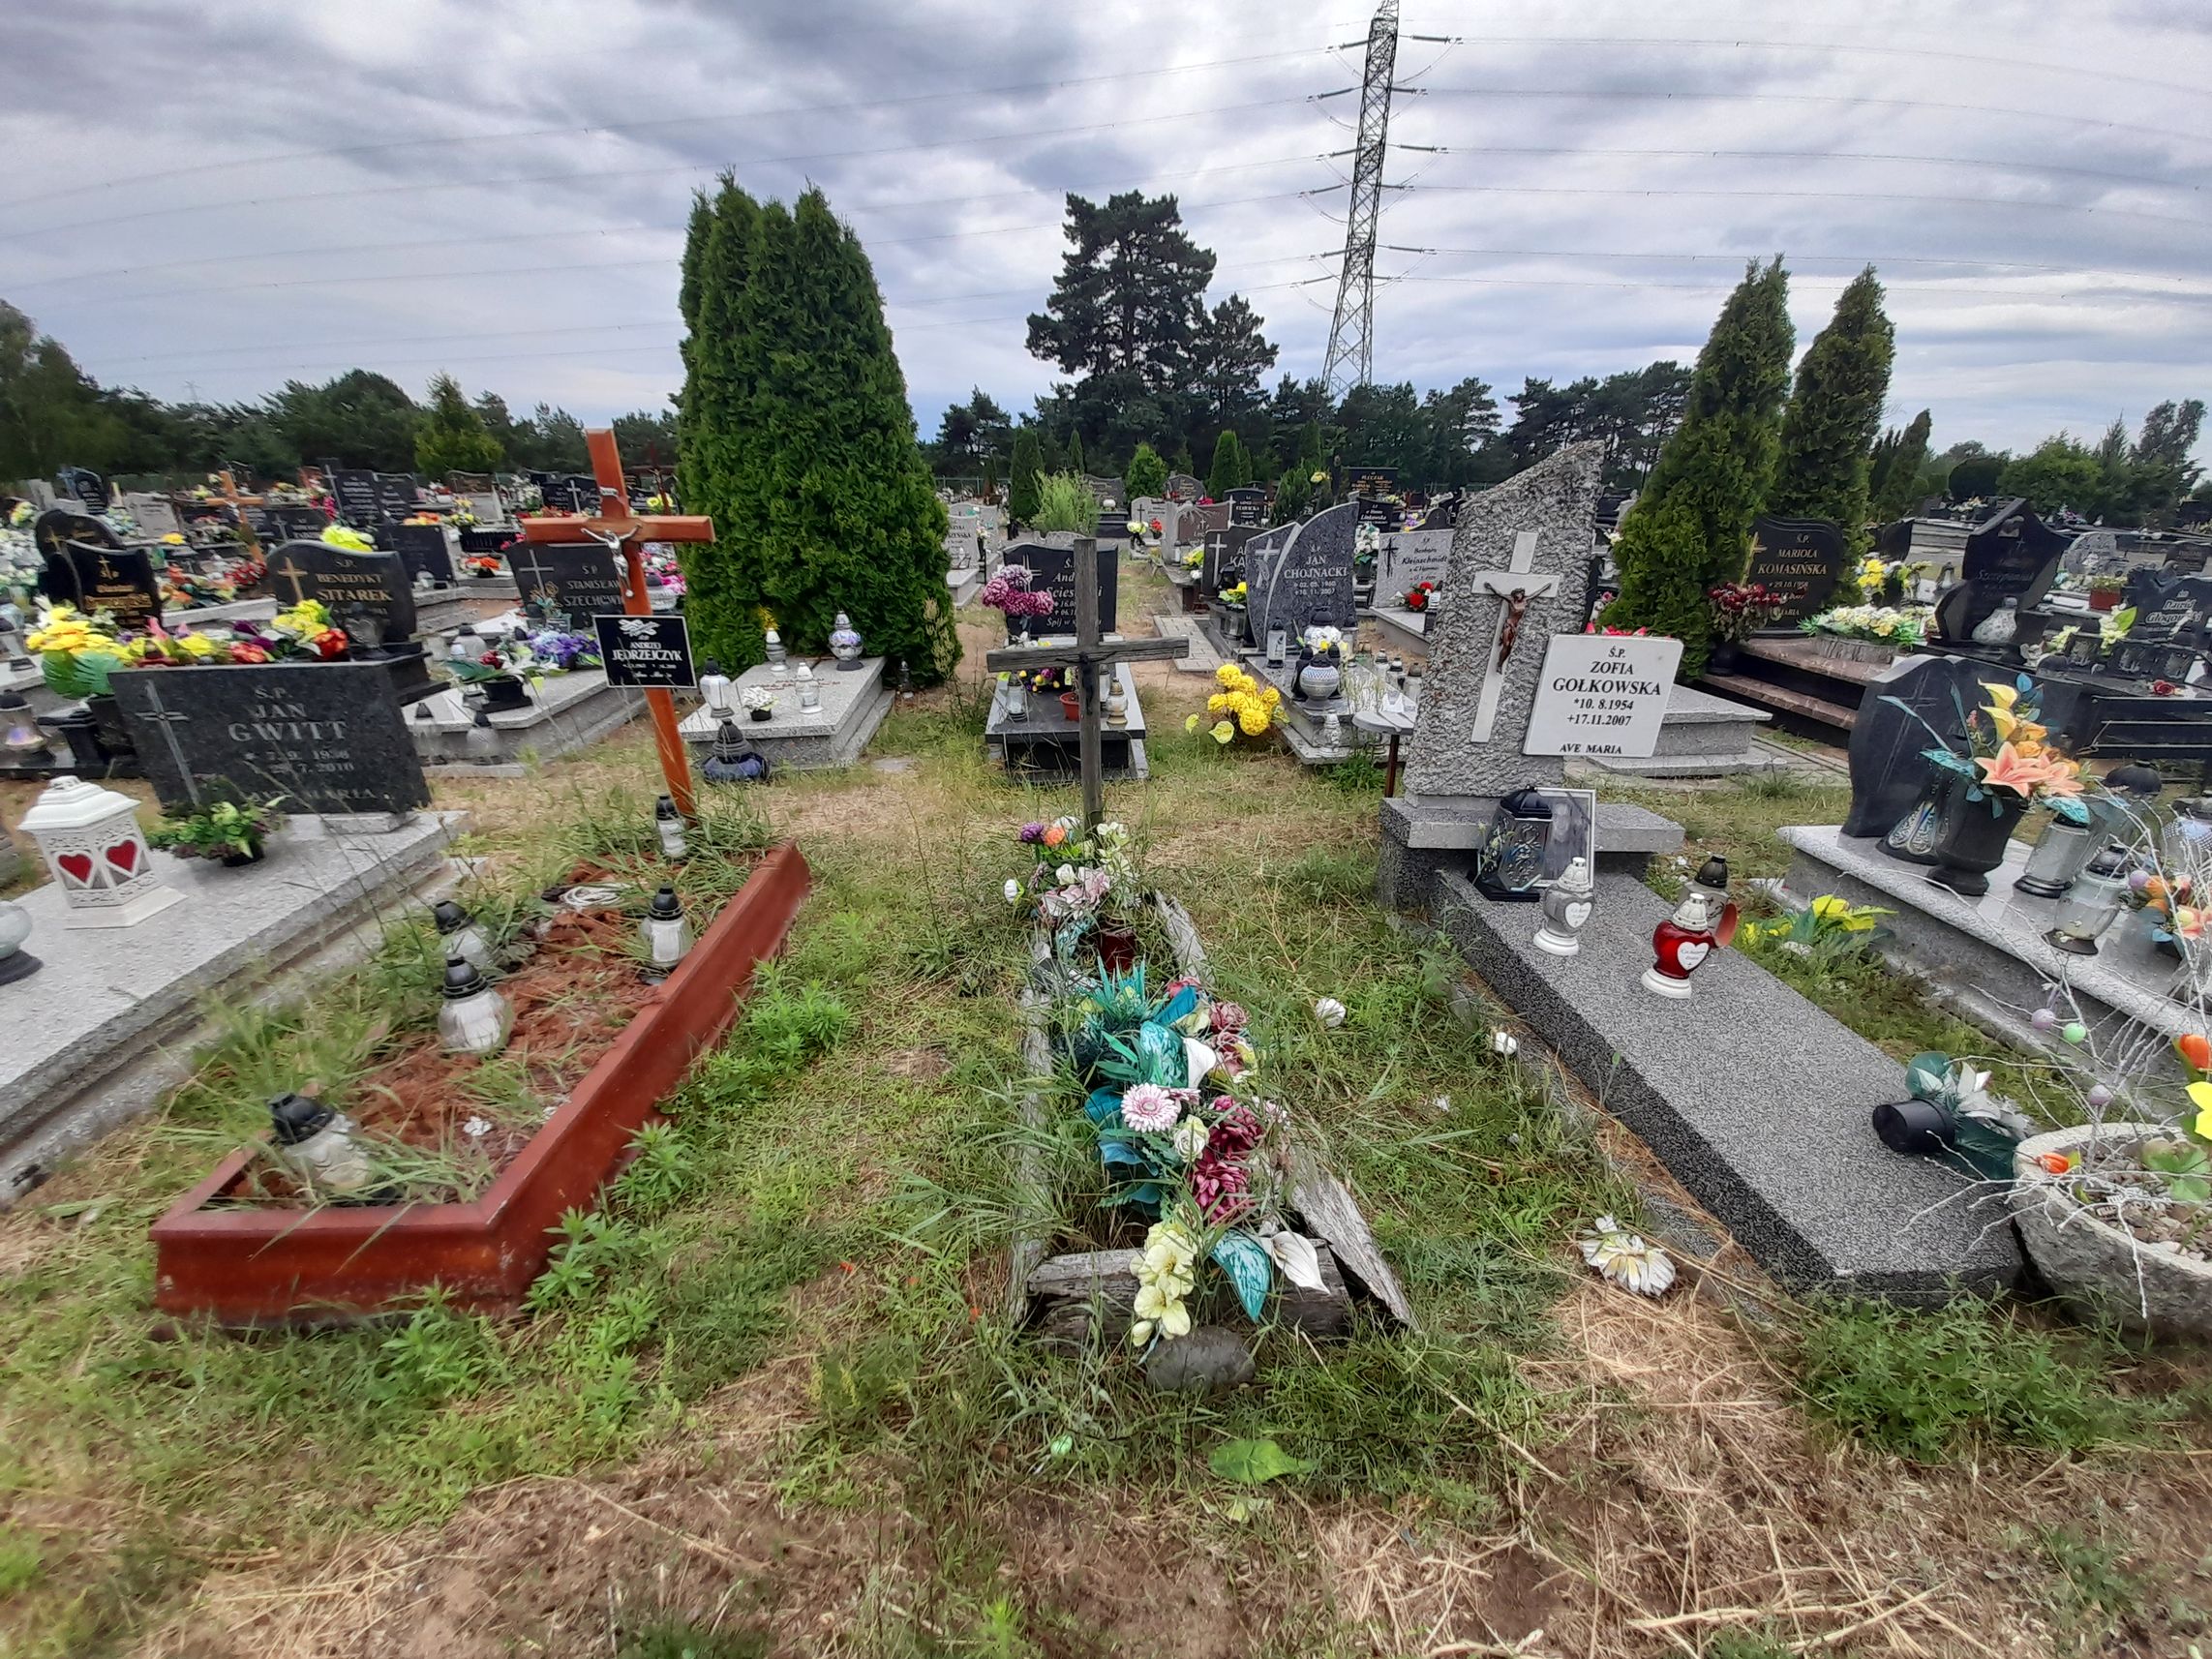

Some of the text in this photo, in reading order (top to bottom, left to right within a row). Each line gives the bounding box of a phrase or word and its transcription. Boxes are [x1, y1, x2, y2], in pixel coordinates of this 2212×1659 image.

[1778, 549, 1818, 558] MARIOLA
[1306, 556, 1327, 565] JAN
[1284, 567, 1348, 579] CHOJNACKI
[1757, 561, 1828, 575] KOMASIŃSKA
[316, 588, 394, 601] SITAREK
[2162, 599, 2197, 610] Dawid
[611, 649, 683, 662] JĘDRZEJCZYK
[1609, 646, 1626, 658] Ś.P.
[1590, 661, 1634, 676] ZOFIA
[1553, 678, 1661, 696] GOŁKOWSKA
[256, 703, 307, 718] JAN
[227, 721, 348, 741] GWITT
[1560, 743, 1622, 754] AVE MARIA
